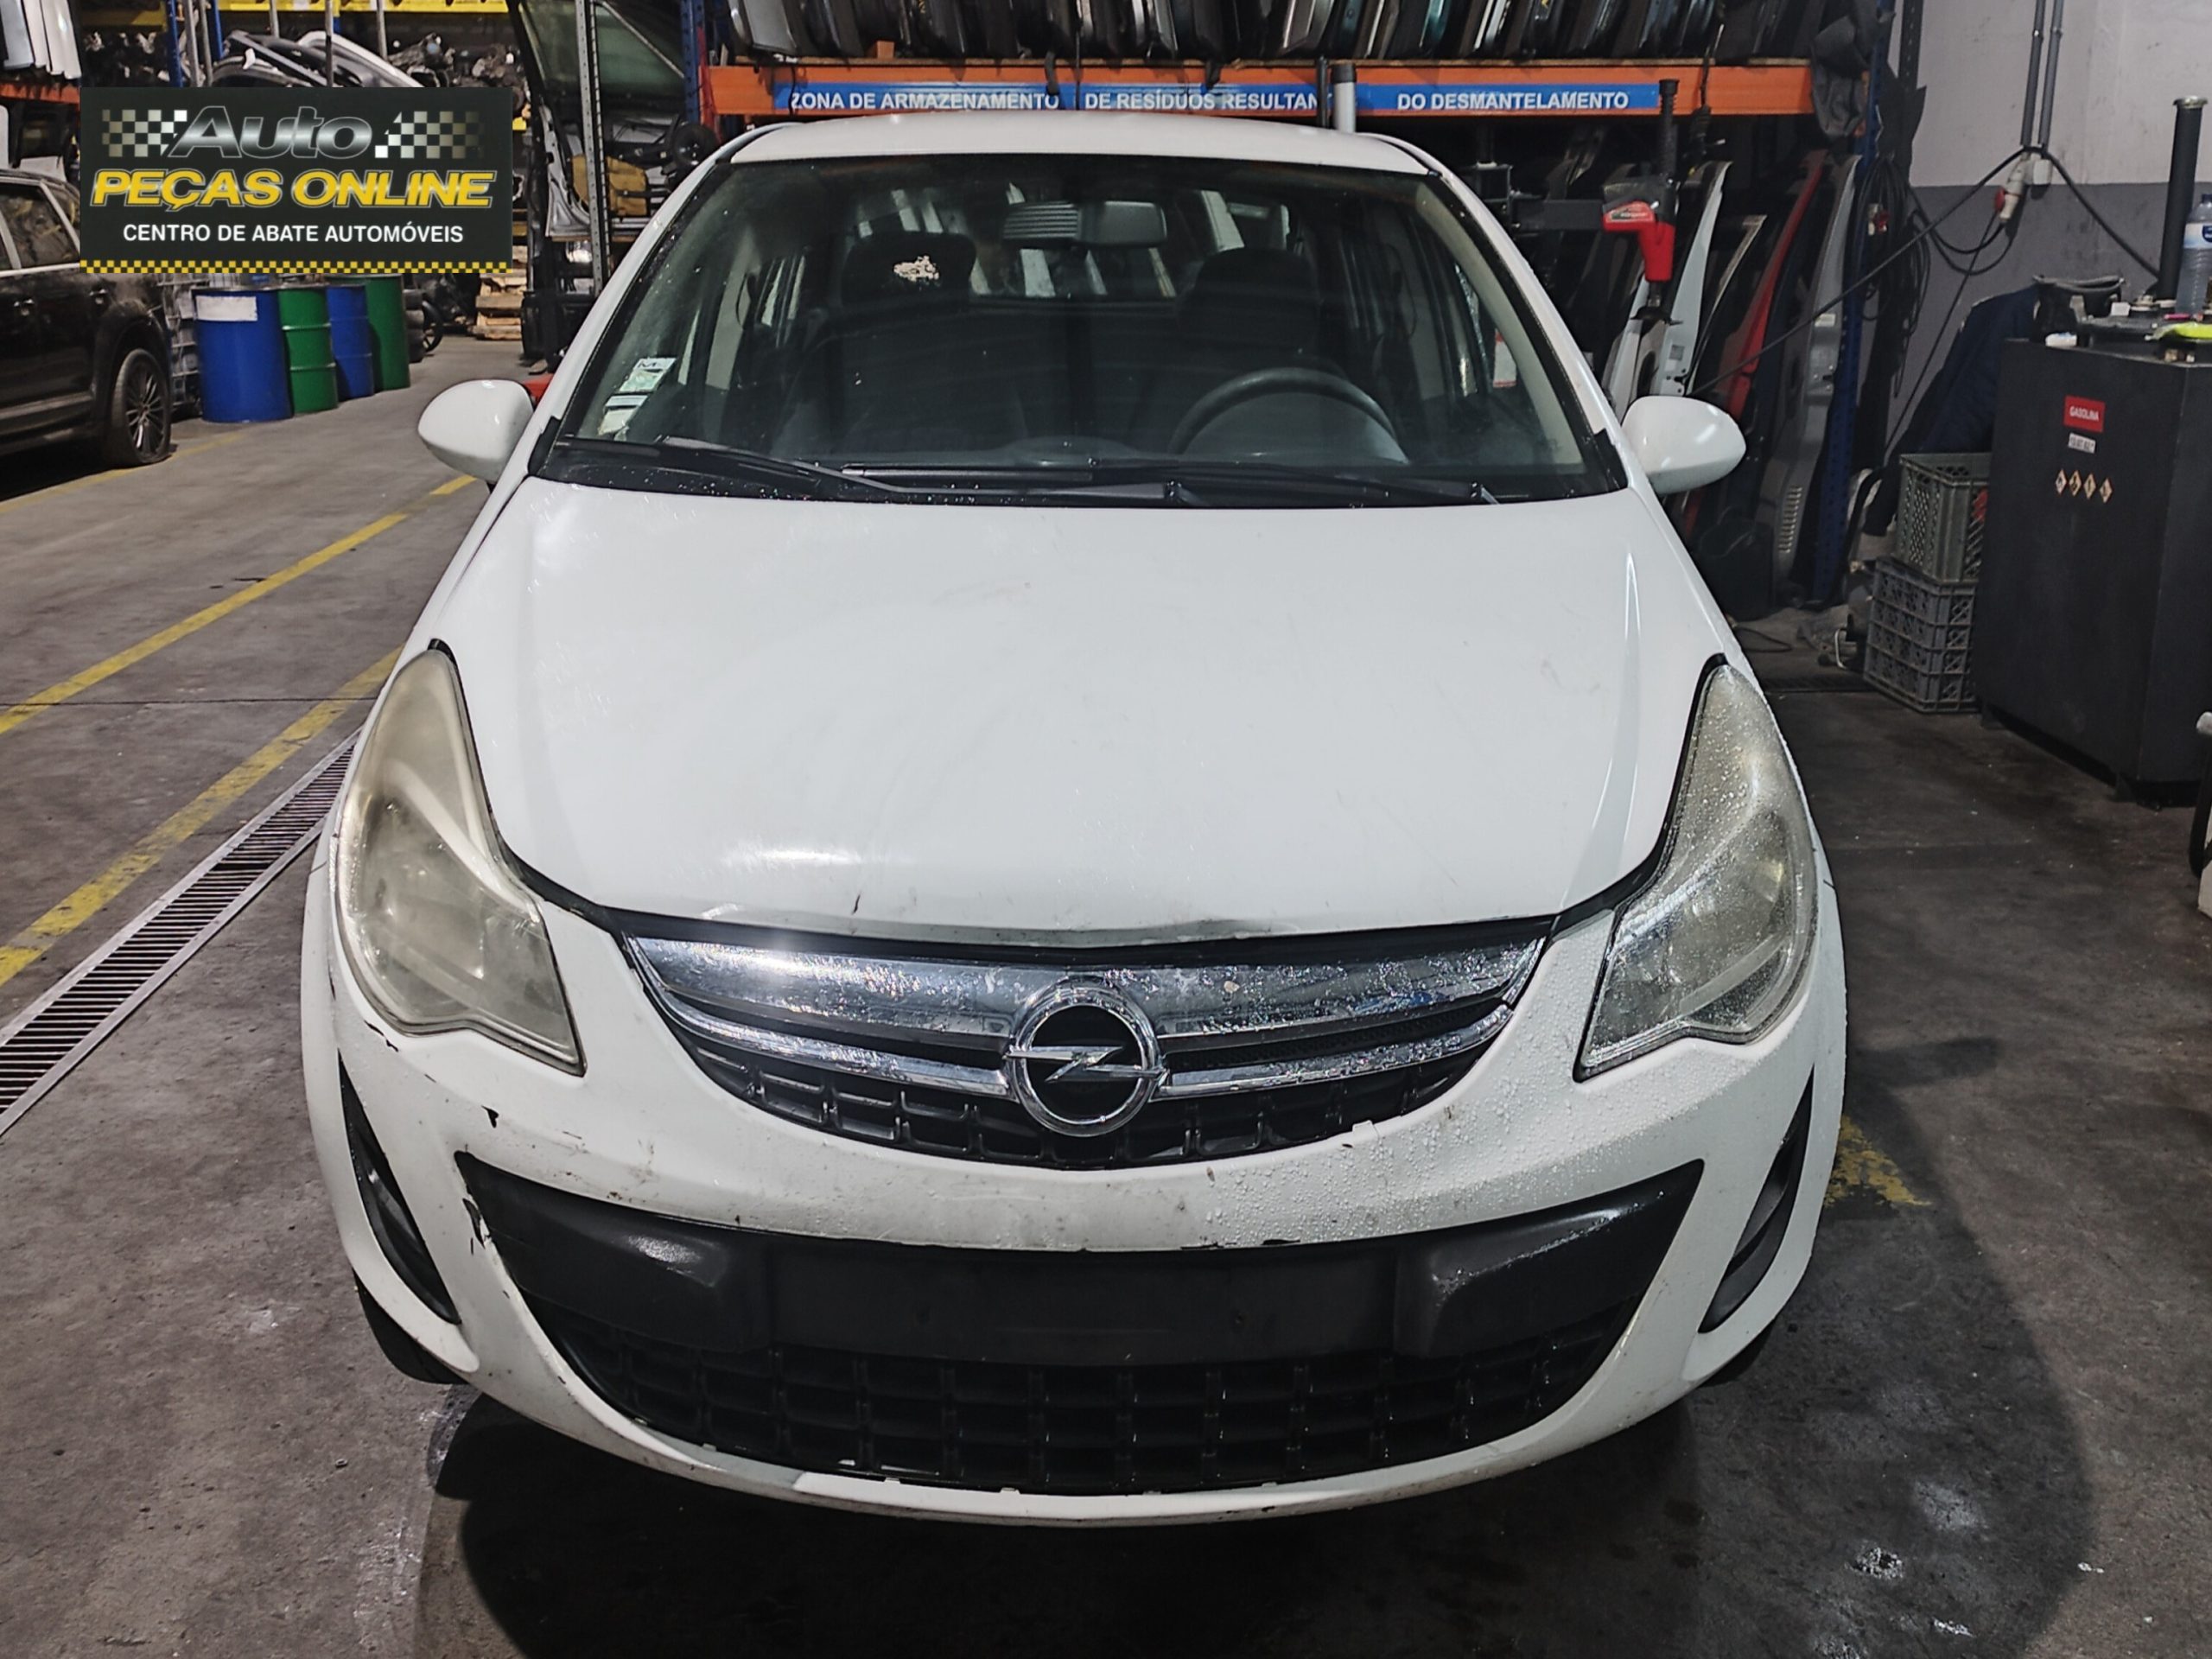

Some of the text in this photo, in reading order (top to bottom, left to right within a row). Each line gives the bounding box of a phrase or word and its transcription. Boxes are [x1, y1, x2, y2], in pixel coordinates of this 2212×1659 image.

[791, 90, 1630, 111] ZONA DE ARMAZENAMENTO DE RESÍDUOS RESULTAN DO DESMANTELAMENTO
